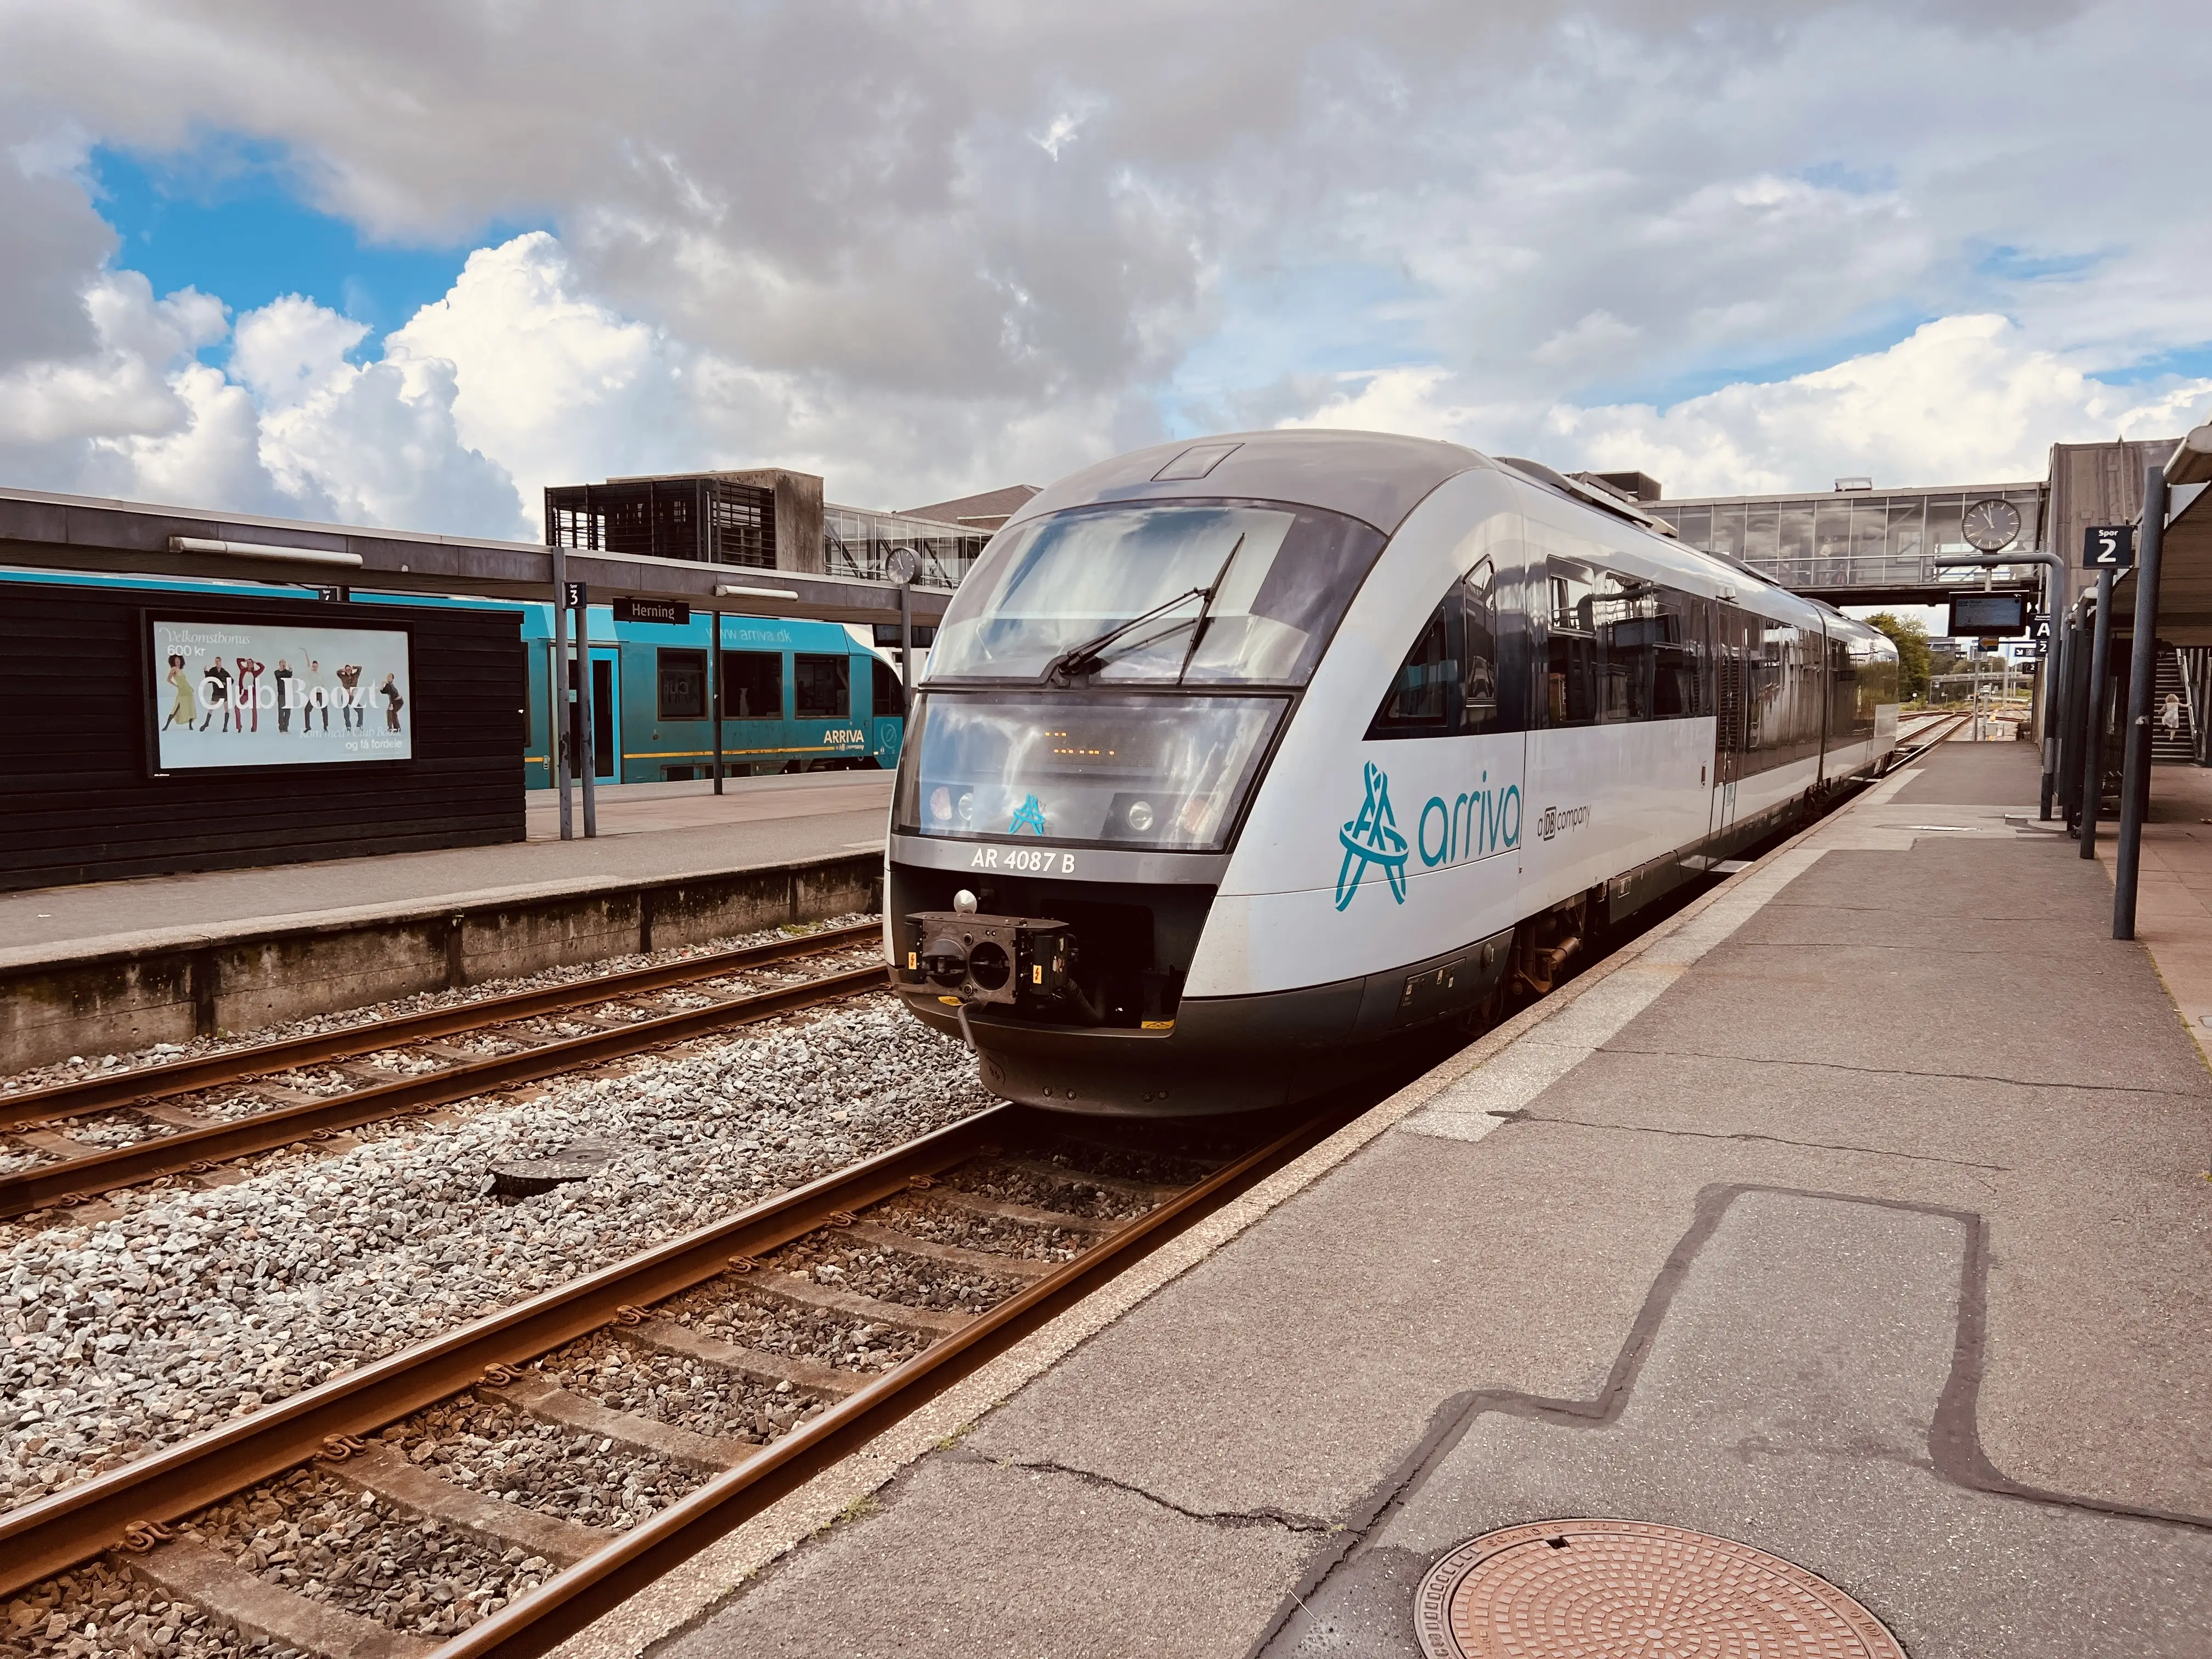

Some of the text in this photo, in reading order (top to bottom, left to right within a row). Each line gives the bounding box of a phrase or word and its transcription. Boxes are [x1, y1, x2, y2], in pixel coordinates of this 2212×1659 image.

[2097, 539, 2116, 562] 2
[570, 590, 578, 605] 3
[632, 603, 675, 620] Herning
[159, 627, 251, 645] Velkomstbonus
[2036, 623, 2051, 636] A
[167, 645, 206, 657] 600 kr
[2039, 643, 2047, 652] 2
[198, 676, 381, 710] Club Boozt
[299, 727, 321, 738] Kom
[823, 730, 865, 744] ARRIVA
[346, 738, 402, 751] og få fordele
[1419, 770, 1521, 867] arriva
[1537, 804, 1591, 838] a DB company
[970, 848, 1075, 874] AR 4087 B
